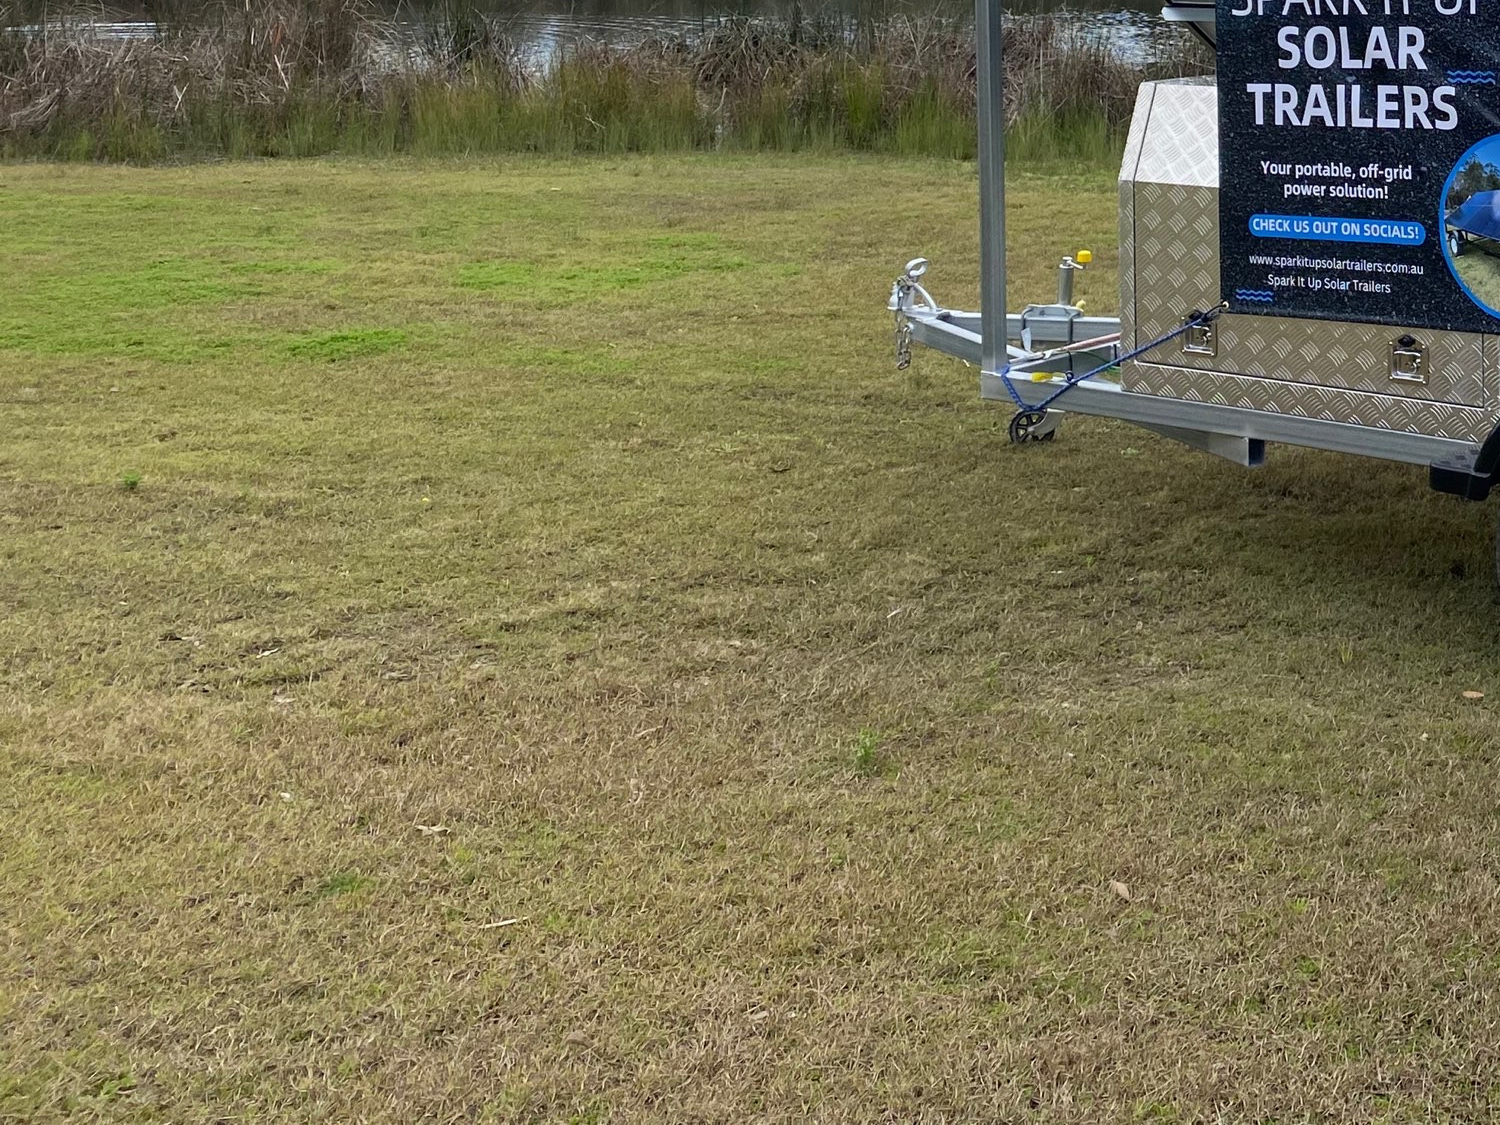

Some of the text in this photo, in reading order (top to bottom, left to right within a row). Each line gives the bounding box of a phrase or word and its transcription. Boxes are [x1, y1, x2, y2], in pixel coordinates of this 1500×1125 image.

[1277, 25, 1428, 70] SOLAR
[1246, 83, 1459, 131] TRAILERS
[1260, 160, 1413, 183] Your portable, off-grid
[1283, 183, 1389, 199] power solution!
[1252, 217, 1419, 239] CHECK US OUT ON SOCIALS!
[1249, 253, 1424, 275] www.sparkitupsolartrailers.com.au
[1267, 274, 1391, 293] Spark It Up Solar Trailers
